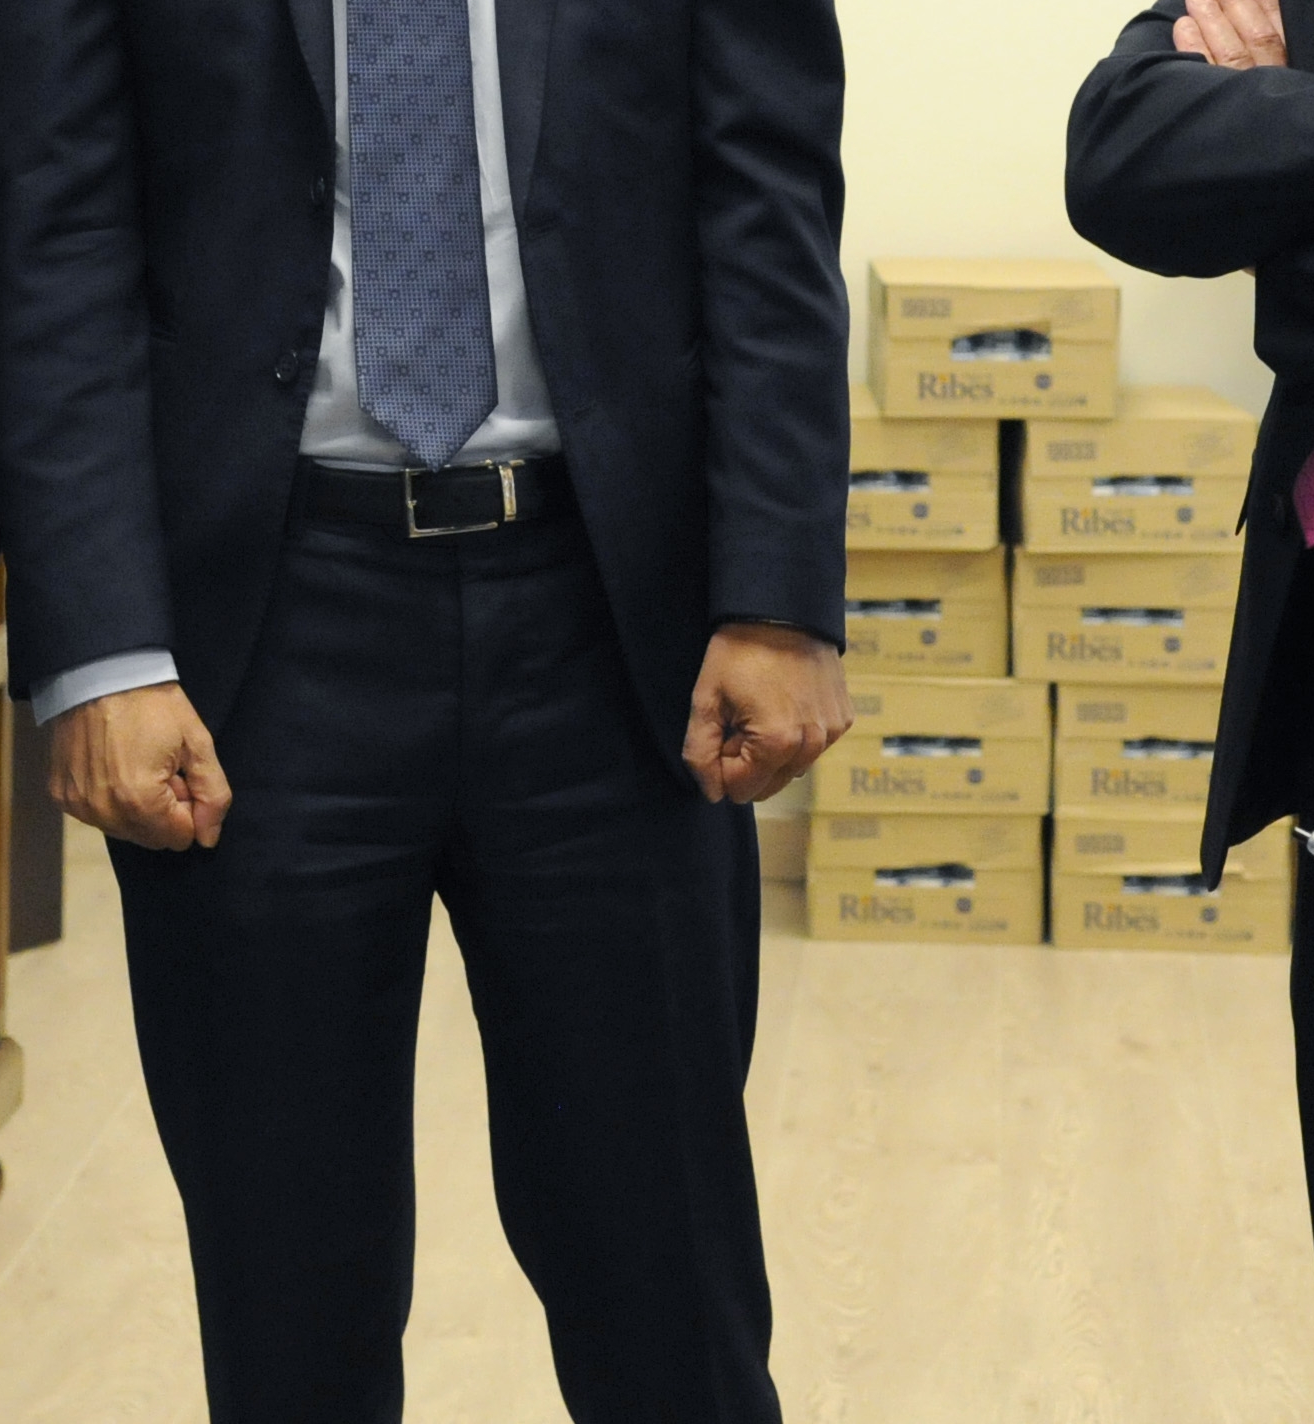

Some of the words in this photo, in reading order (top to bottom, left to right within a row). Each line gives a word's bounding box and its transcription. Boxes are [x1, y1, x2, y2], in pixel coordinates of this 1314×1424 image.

[918, 372, 994, 401] Ribes
[1060, 507, 1136, 536] Ribes
[1046, 632, 1122, 661] Ribes
[850, 767, 926, 796] Ribes
[1091, 767, 1167, 796] Ribes
[839, 894, 915, 923] Ribes
[1083, 902, 1159, 931] Ribes
